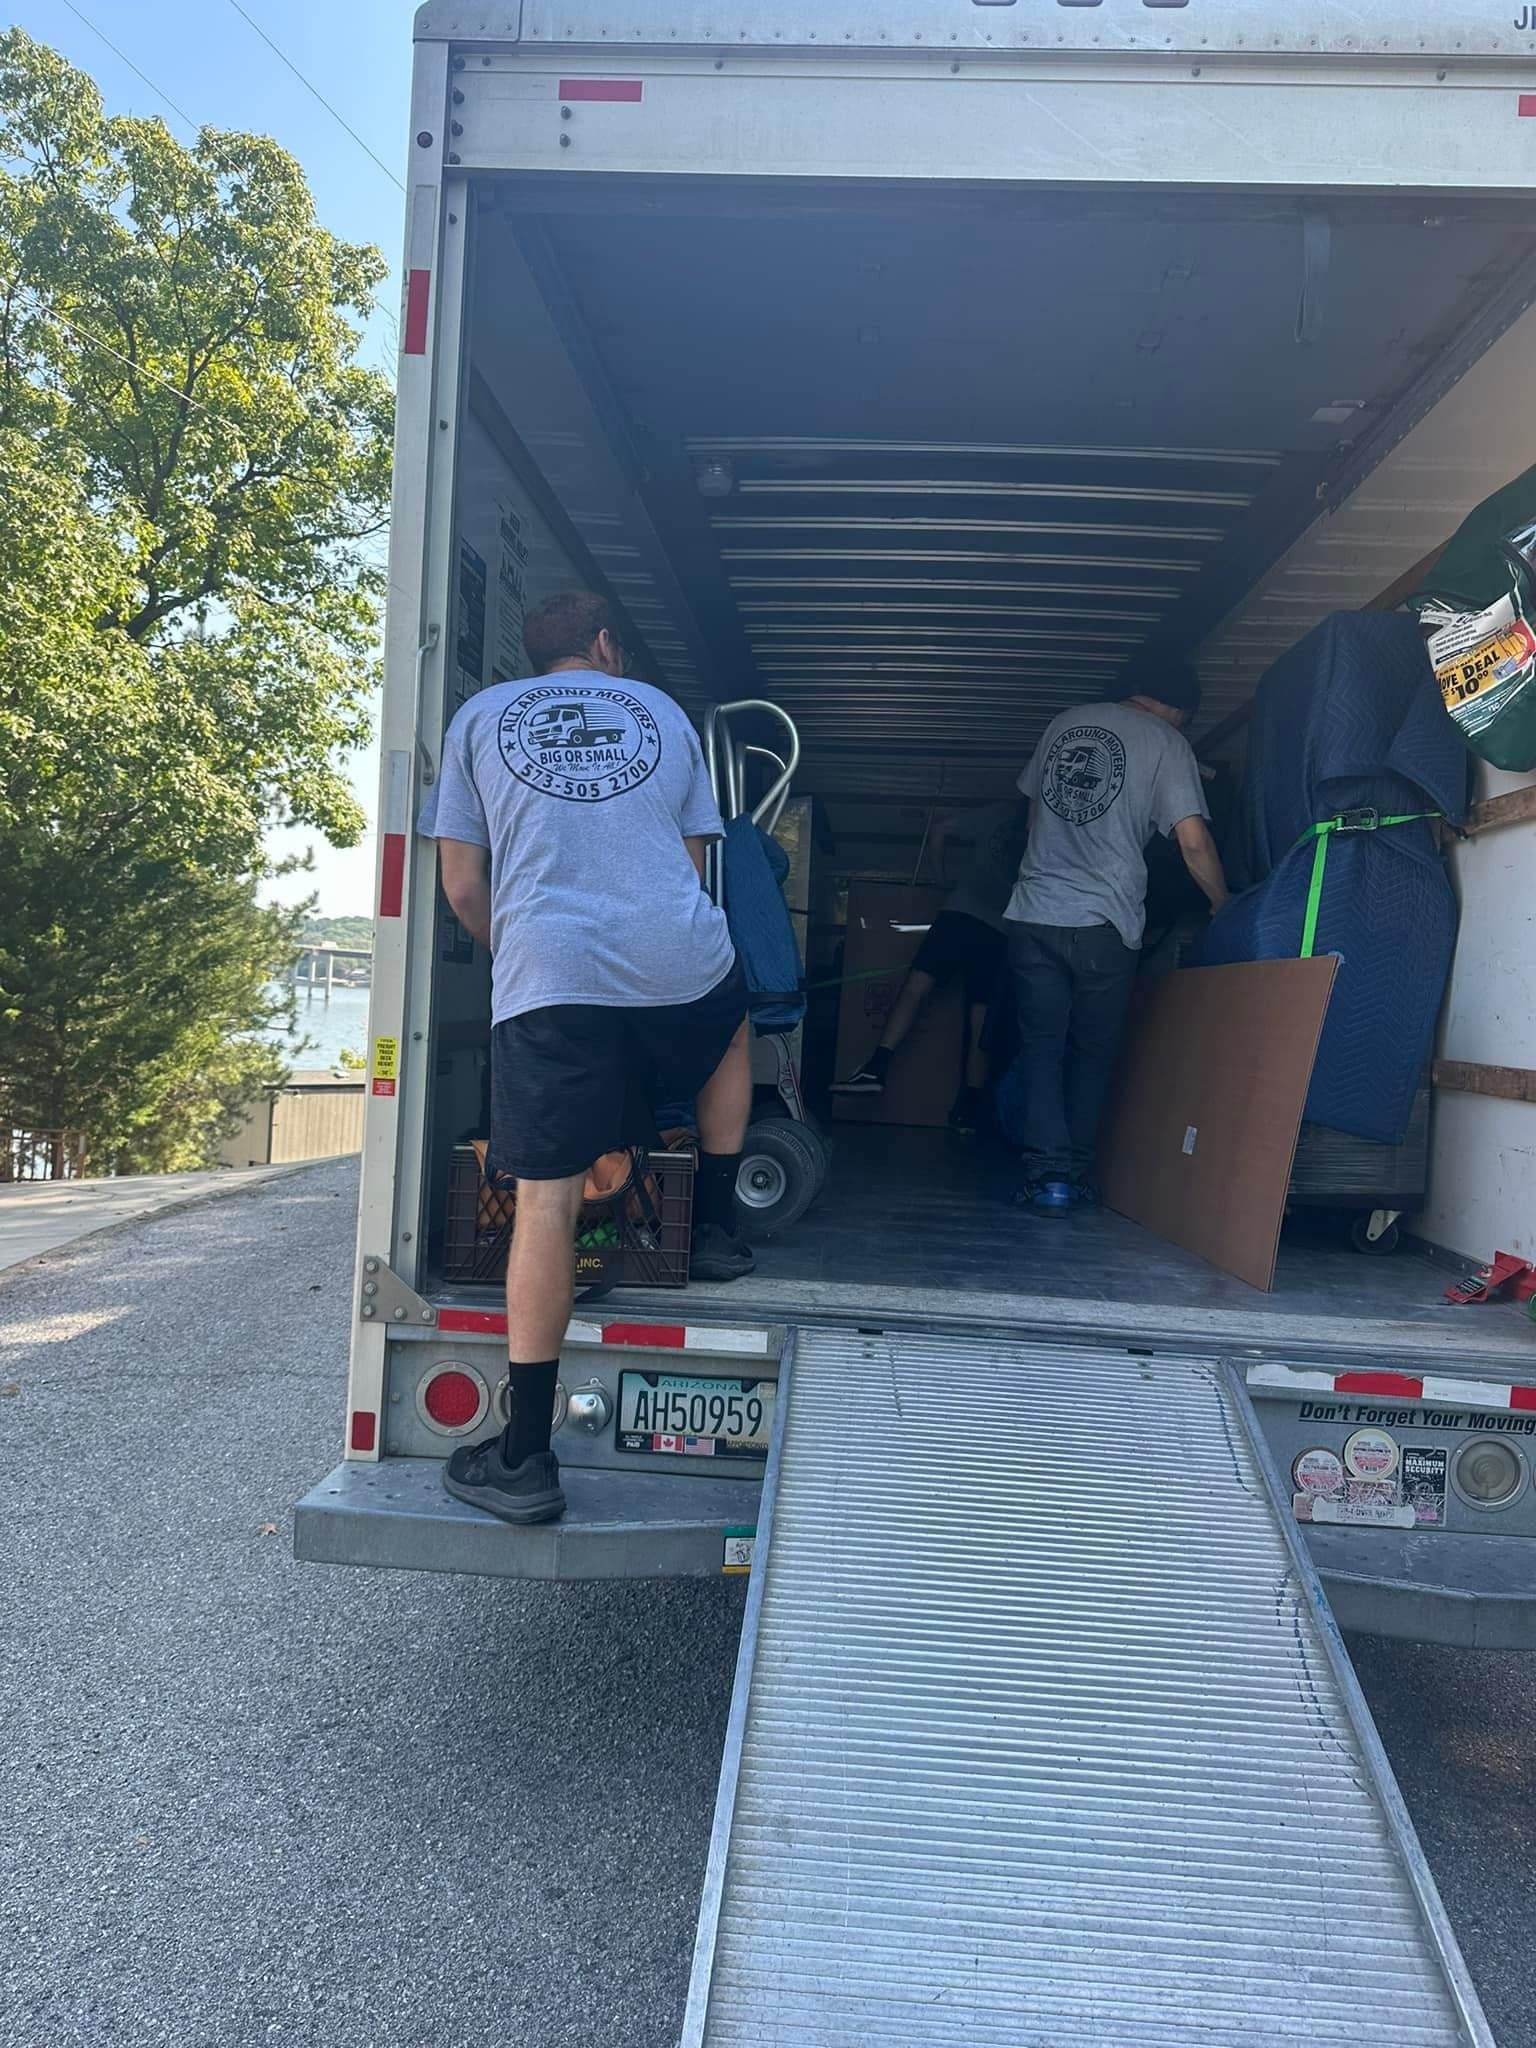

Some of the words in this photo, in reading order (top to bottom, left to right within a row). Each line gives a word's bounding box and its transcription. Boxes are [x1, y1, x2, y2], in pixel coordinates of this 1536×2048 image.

[1462, 650, 1500, 680] DEAL
[502, 710, 524, 733] ALL
[517, 688, 592, 710] AROUND
[595, 690, 655, 730] MOVERS
[539, 750, 562, 765] BIG
[564, 749, 583, 763] OR
[585, 748, 628, 763] SMALL
[1048, 743, 1062, 762] ALL
[1061, 728, 1106, 742] AROUND
[1104, 736, 1123, 778] MOVERS
[519, 762, 601, 798] 573-505
[611, 758, 650, 792] 2700
[661, 1378, 741, 1392] ARIZONA
[633, 1391, 763, 1437] AH50959
[1299, 1401, 1350, 1420] Don't
[1356, 1406, 1416, 1427] Forget
[1422, 1409, 1463, 1427] Your
[1405, 1459, 1445, 1467] MAXIMUM
[1405, 1466, 1445, 1475] SECURITY
